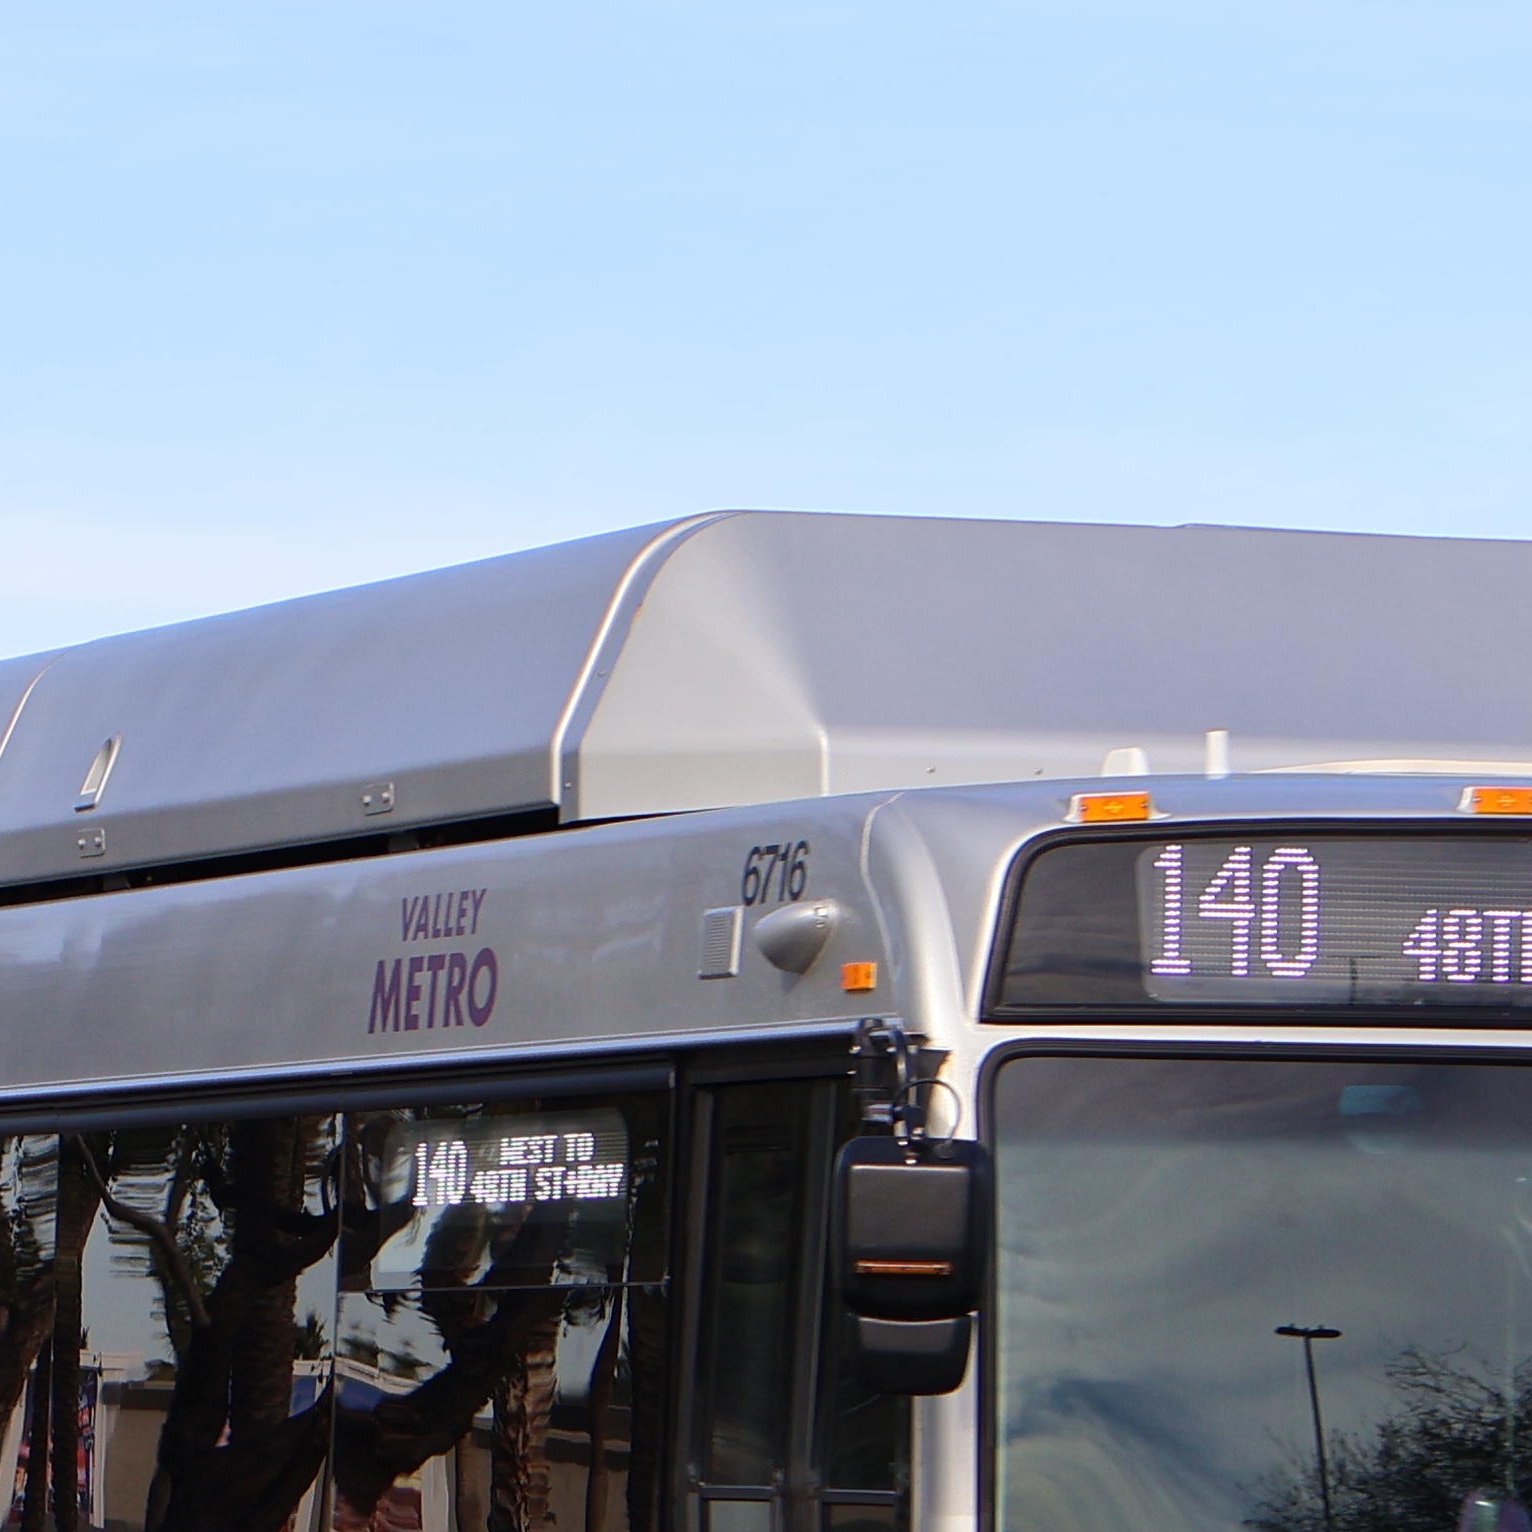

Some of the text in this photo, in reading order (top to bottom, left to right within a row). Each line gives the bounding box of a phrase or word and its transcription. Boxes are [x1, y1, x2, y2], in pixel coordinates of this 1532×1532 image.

[741, 840, 810, 906] 6716
[401, 888, 487, 942] VALLEY
[1151, 844, 1320, 977] 140
[367, 947, 498, 1034] METRO
[413, 1141, 468, 1206] 140
[499, 1132, 595, 1166] WEST TO
[469, 1168, 528, 1203] 48TH
